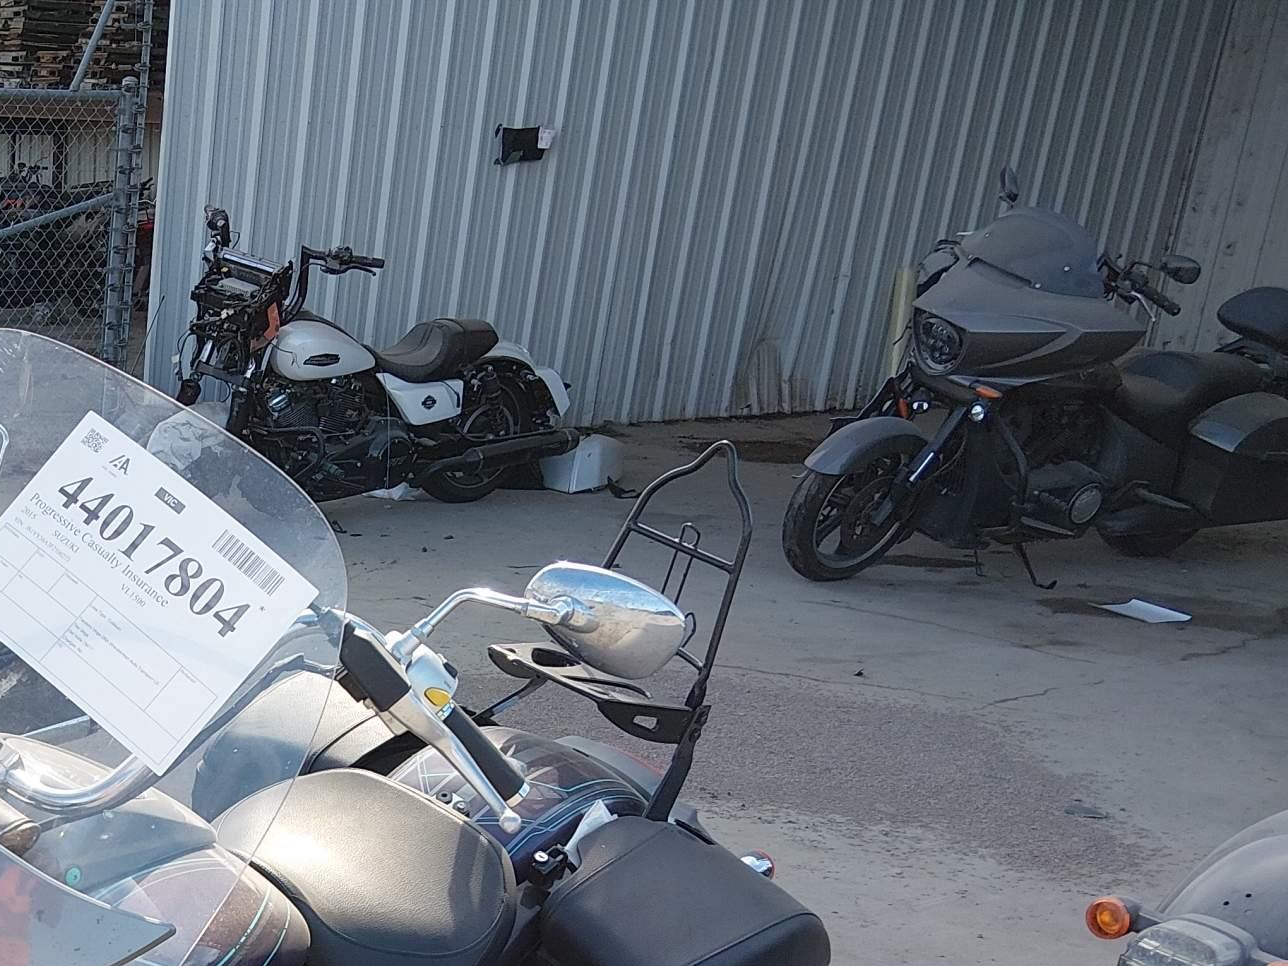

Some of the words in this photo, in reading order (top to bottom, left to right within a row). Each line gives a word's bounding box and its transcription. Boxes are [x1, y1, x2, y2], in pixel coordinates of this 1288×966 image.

[163, 492, 179, 507] VIC
[29, 492, 81, 537] Progressive
[81, 532, 122, 569] Casualty
[121, 564, 169, 608] Insurance
[53, 529, 80, 553] SUZUKI
[120, 583, 146, 608] VL1500
[58, 477, 251, 638] 44017804
